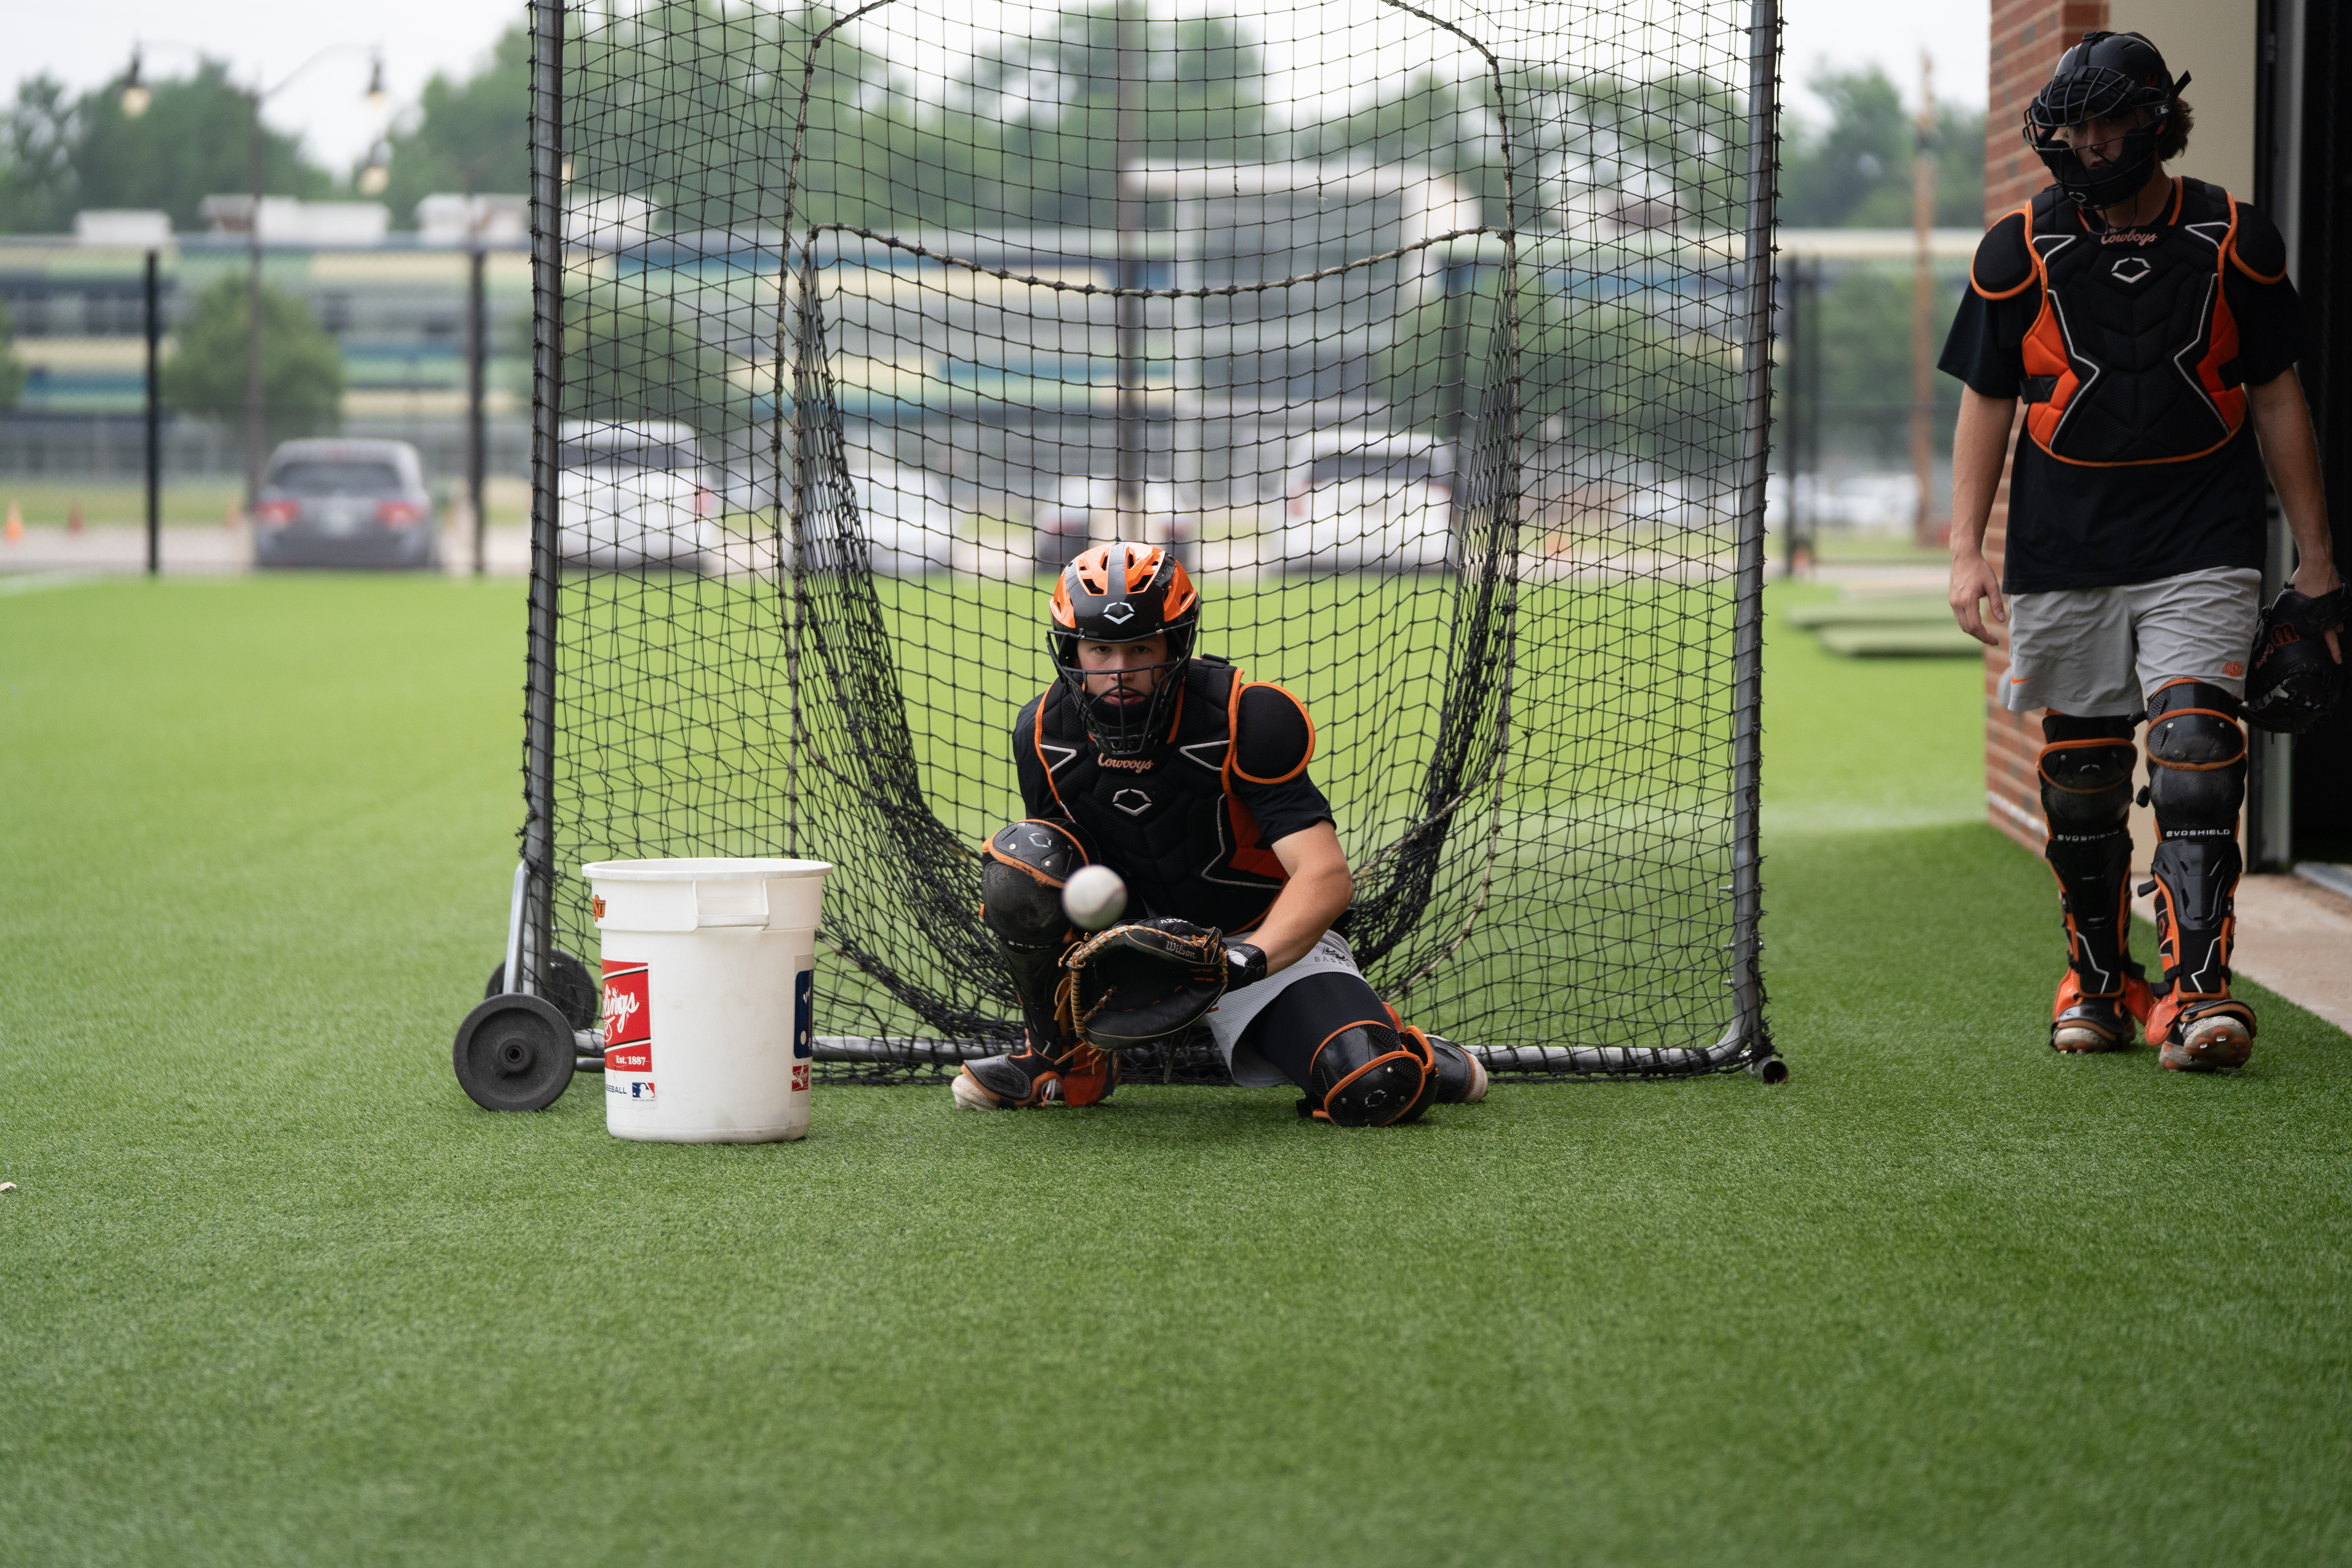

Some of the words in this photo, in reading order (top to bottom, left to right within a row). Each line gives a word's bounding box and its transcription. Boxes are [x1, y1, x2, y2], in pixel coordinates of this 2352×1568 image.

[2101, 228, 2158, 246] Cowboys
[616, 1055, 627, 1064] Est.
[628, 1056, 646, 1066] 1887
[606, 1084, 627, 1094] SEBALL
